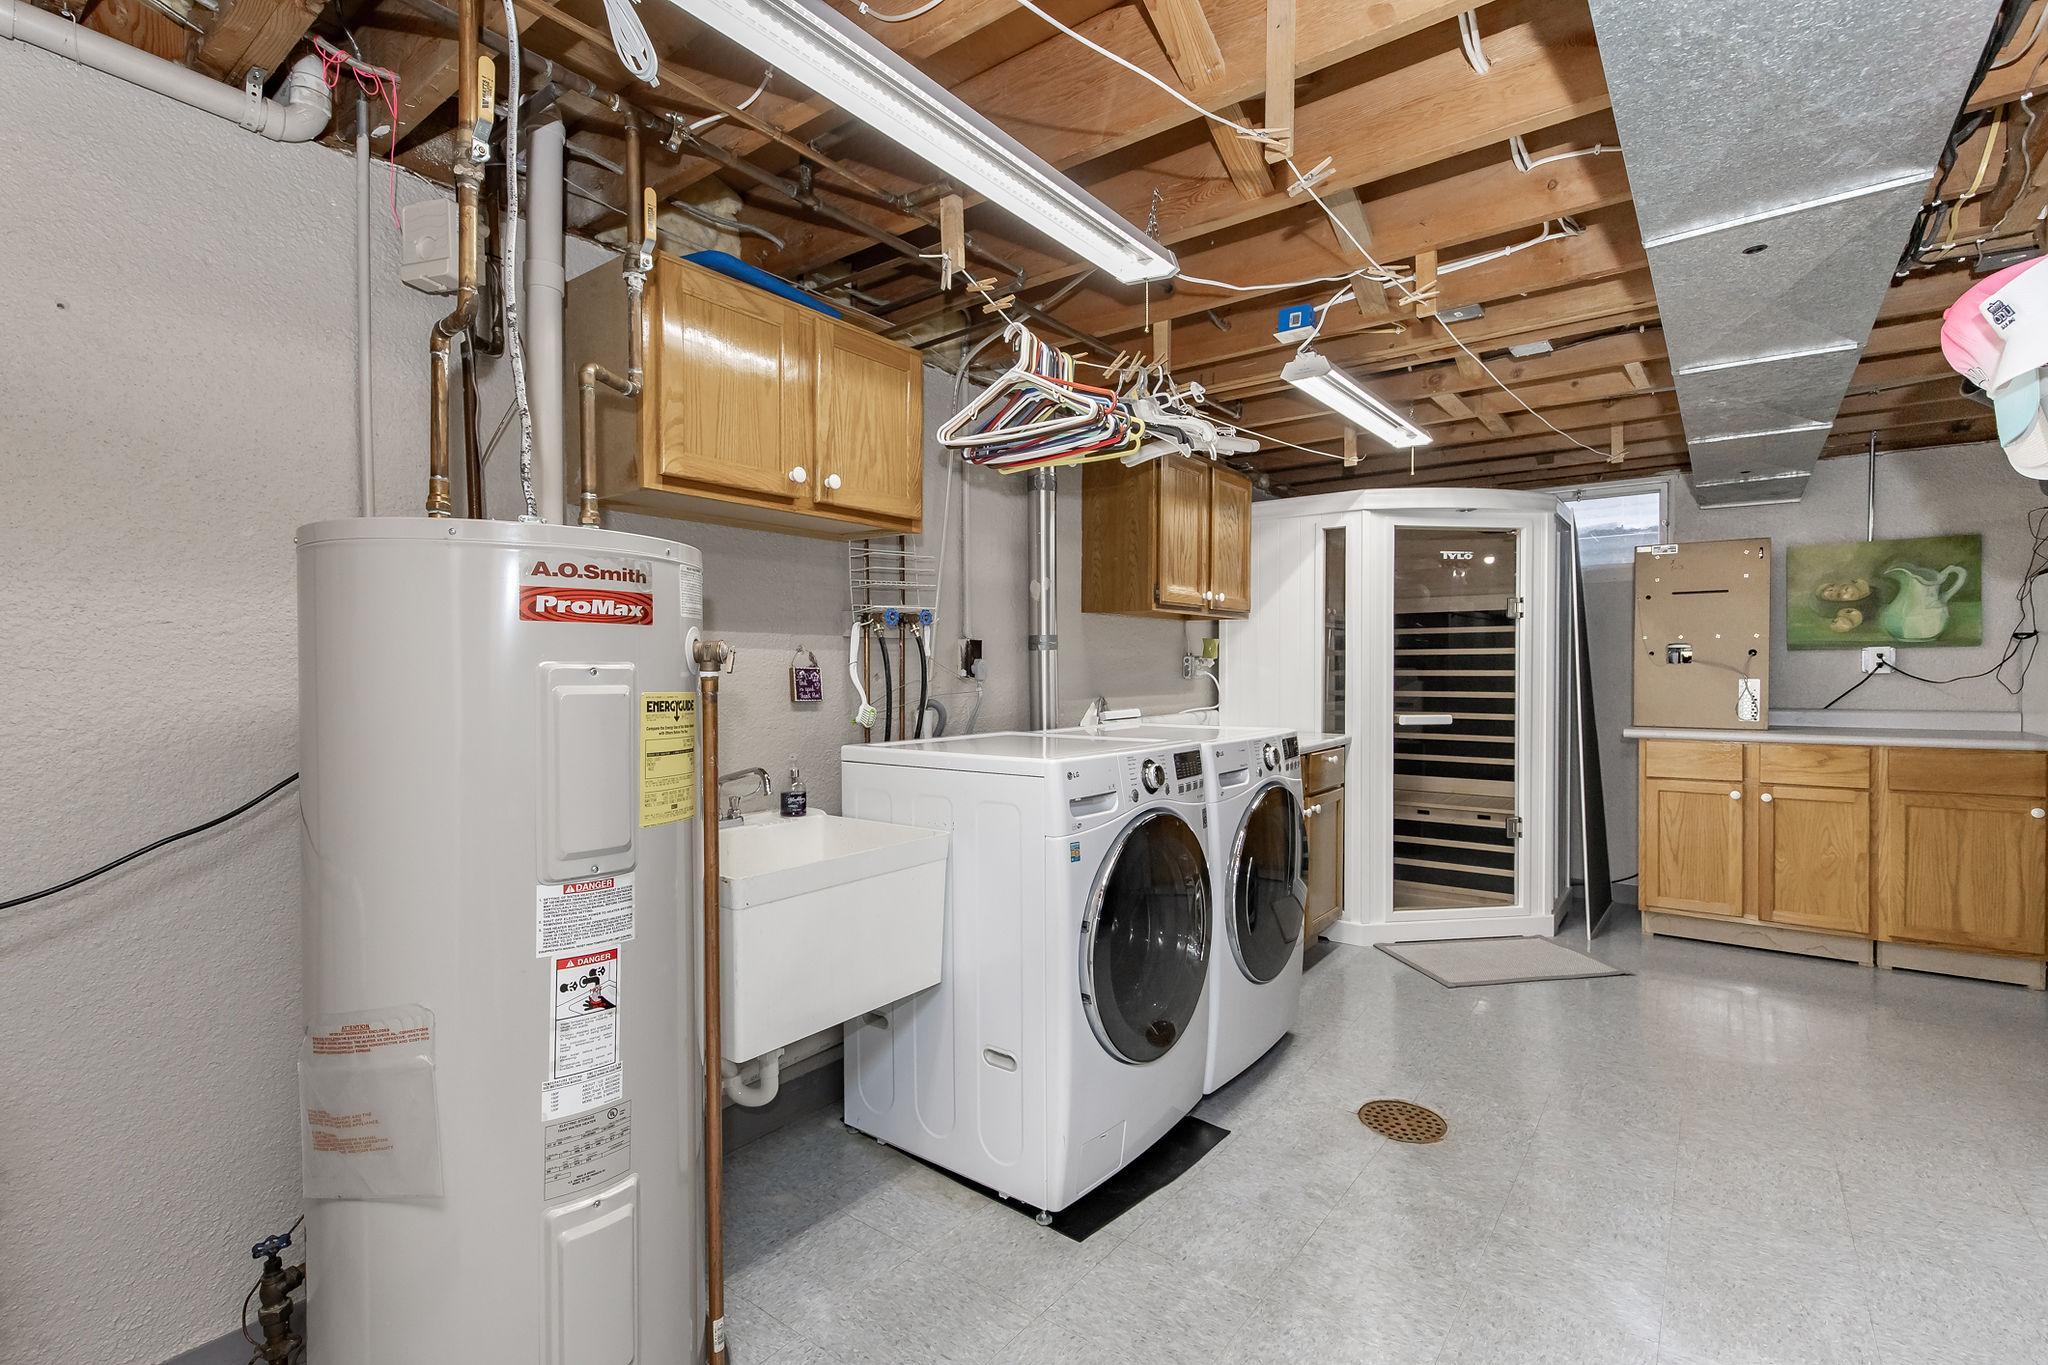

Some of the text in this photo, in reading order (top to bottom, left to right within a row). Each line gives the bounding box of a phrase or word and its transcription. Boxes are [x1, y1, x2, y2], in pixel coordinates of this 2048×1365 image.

[535, 595, 644, 617] ProMax
[576, 879, 613, 892] DANGER
[577, 953, 611, 966] DANGER
